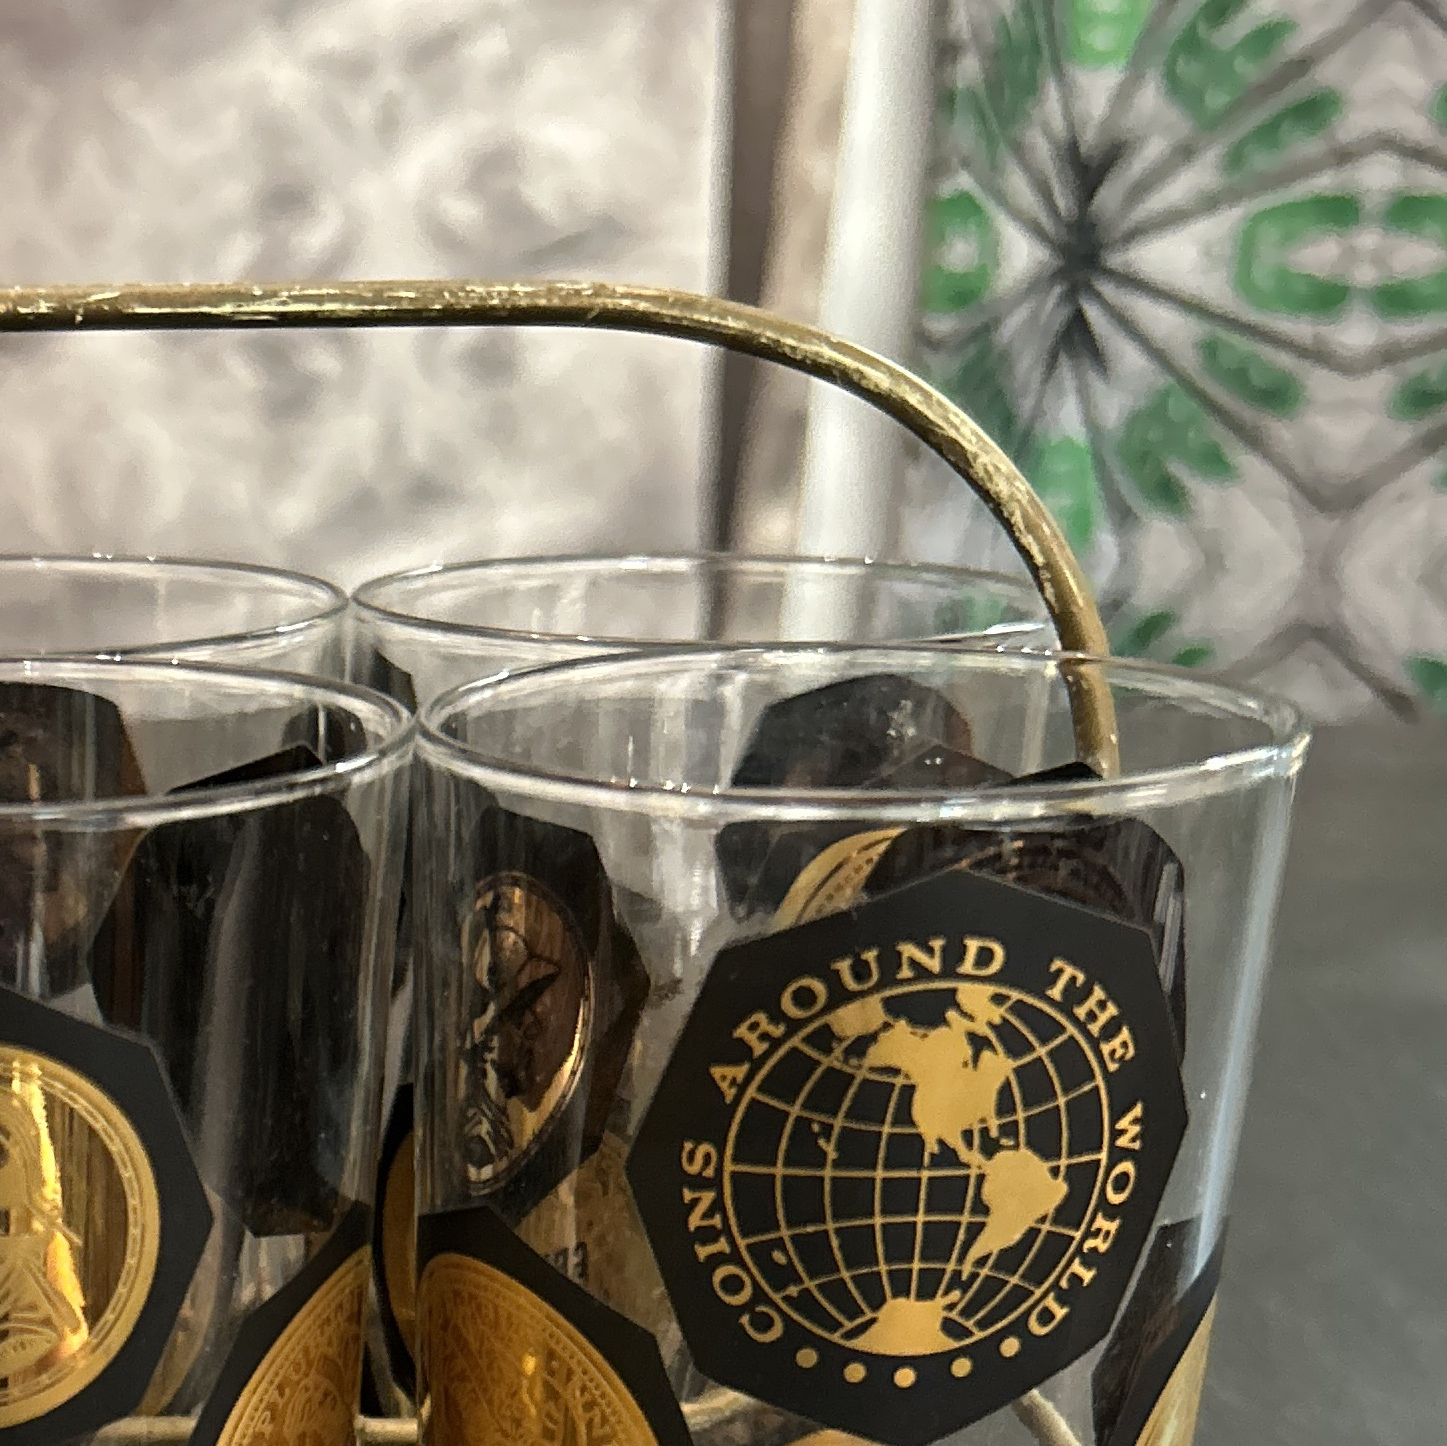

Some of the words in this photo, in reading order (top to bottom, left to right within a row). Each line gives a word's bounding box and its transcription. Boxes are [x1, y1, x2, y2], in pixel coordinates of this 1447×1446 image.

[708, 937, 1007, 1105] AROUND
[1045, 957, 1136, 1072] THE
[681, 1140, 784, 1343] COINS
[1028, 1102, 1143, 1336] WORLD
